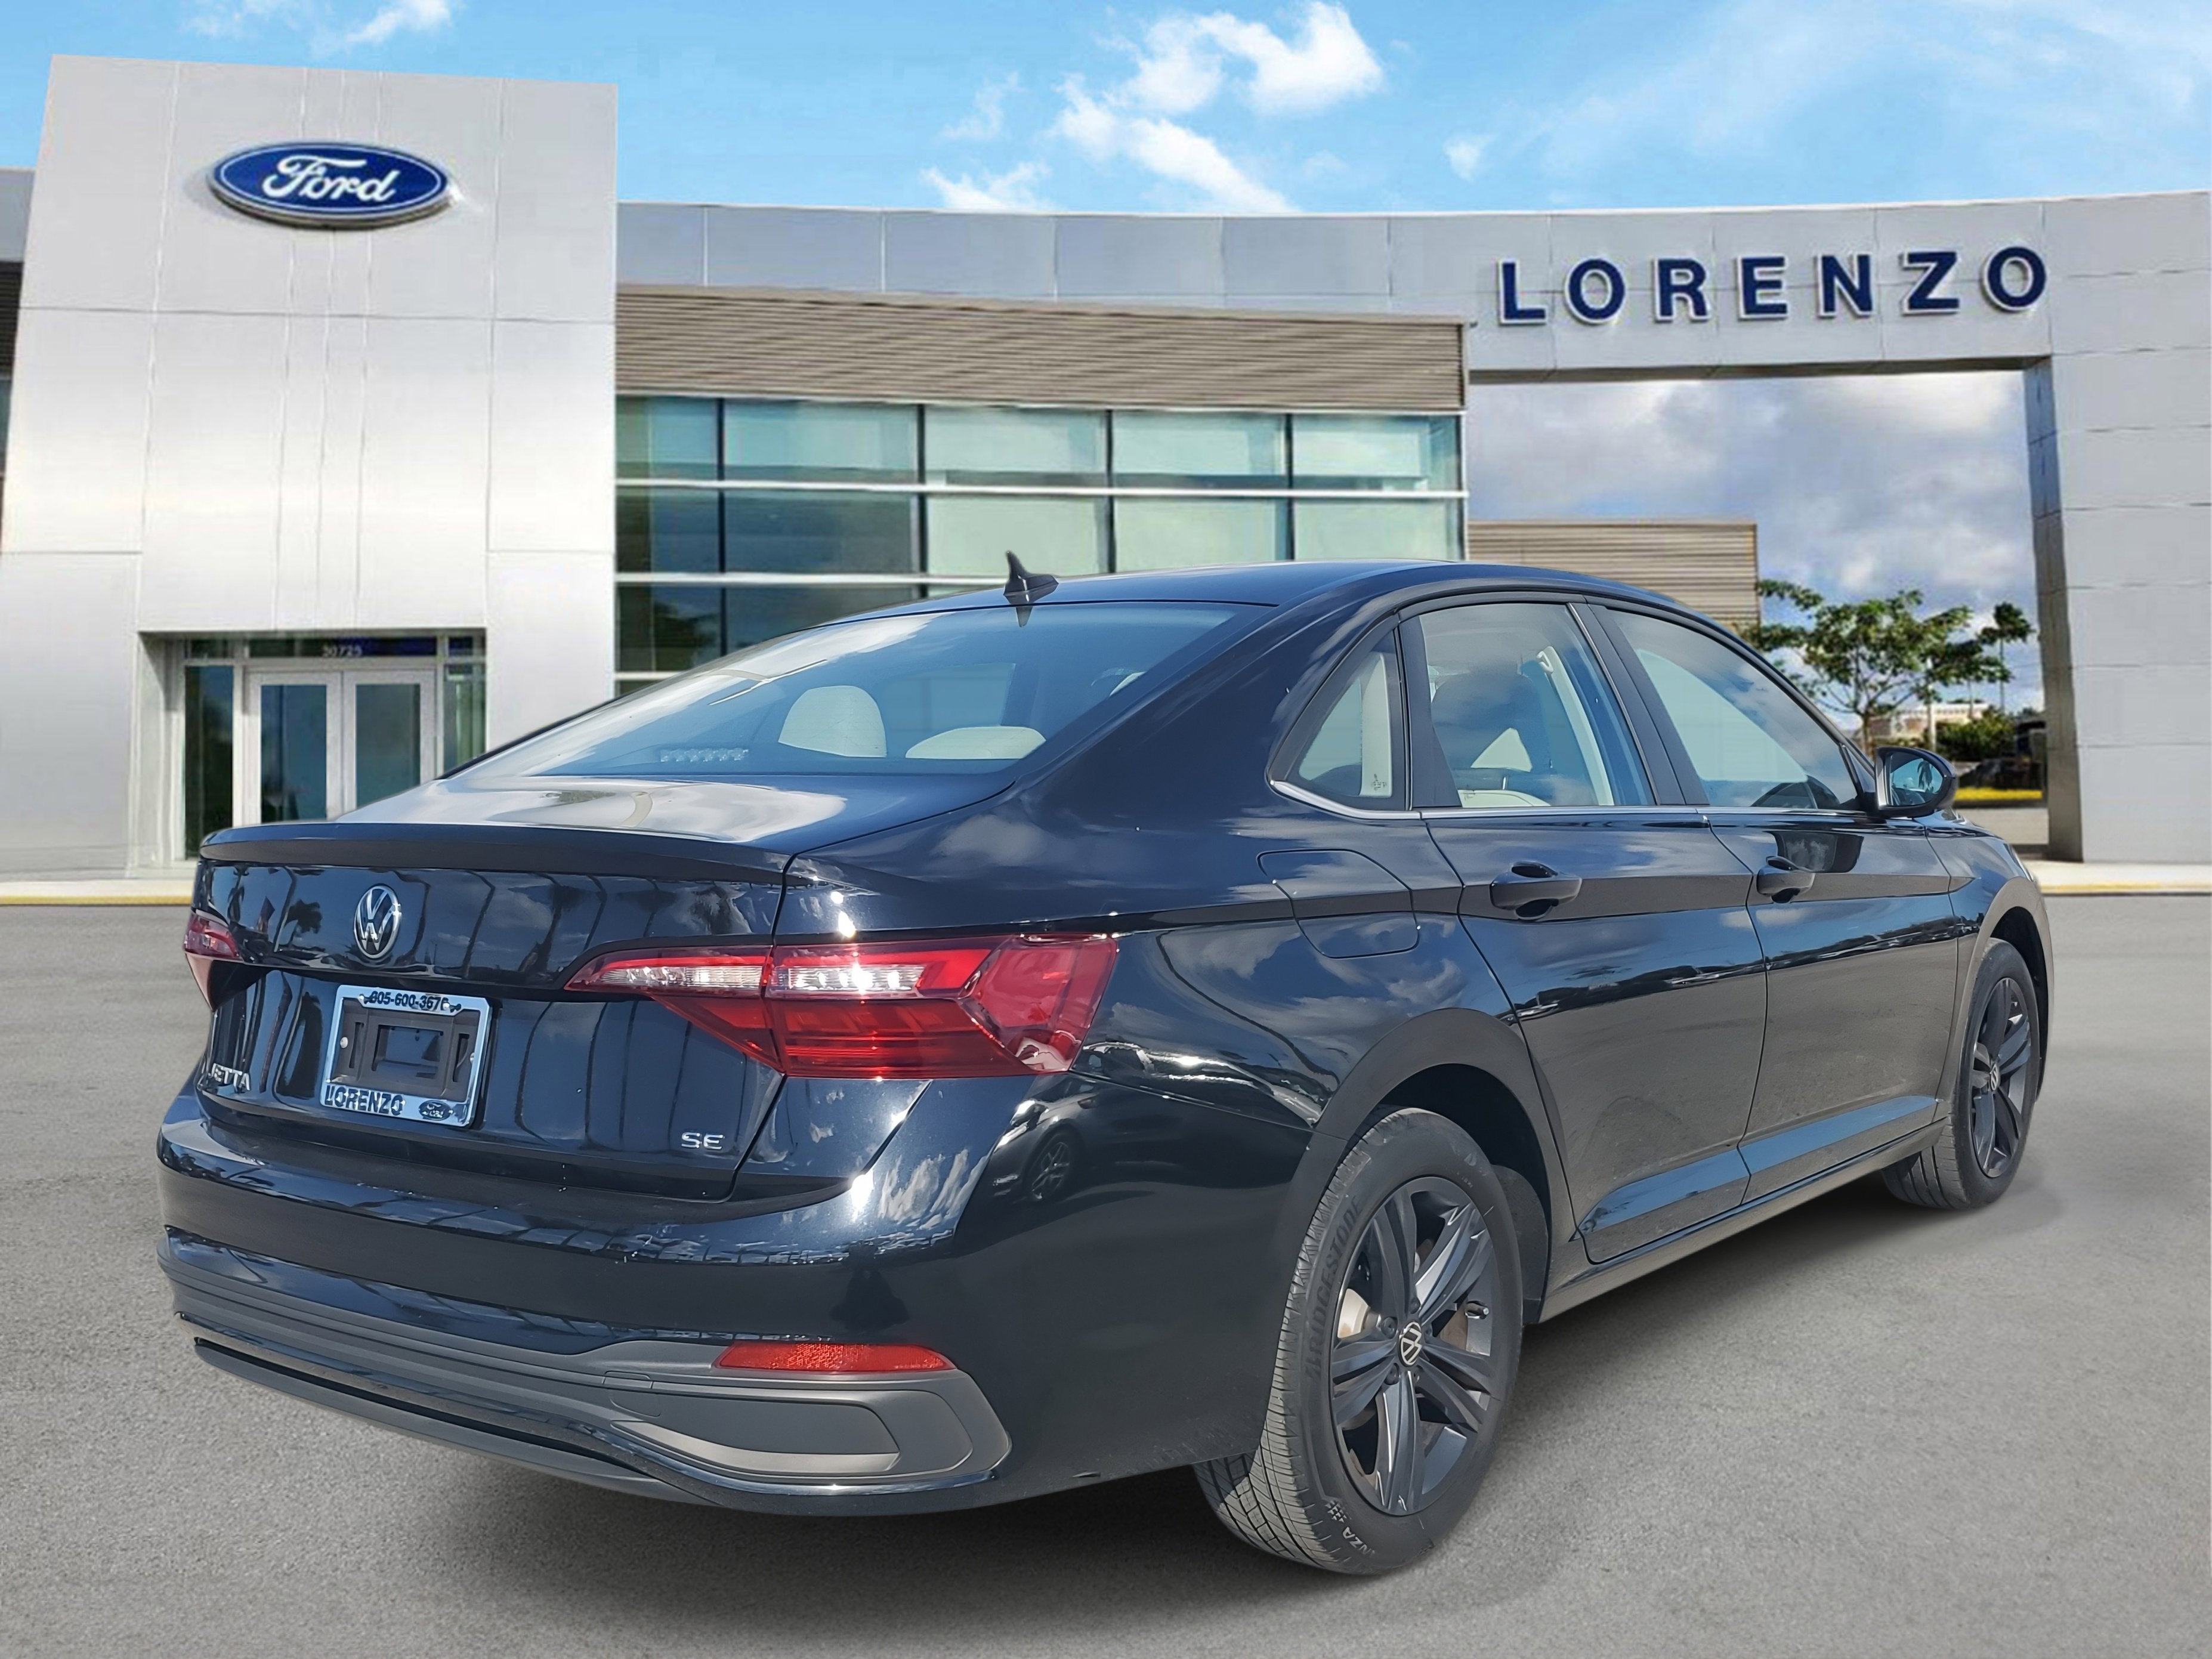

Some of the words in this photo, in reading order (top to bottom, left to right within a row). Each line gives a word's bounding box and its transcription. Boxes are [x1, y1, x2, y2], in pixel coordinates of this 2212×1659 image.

[262, 154, 400, 202] Ford
[1498, 246, 2049, 325] LORENZO
[325, 1085, 404, 1116] LORENZO
[681, 1132, 724, 1150] SE
